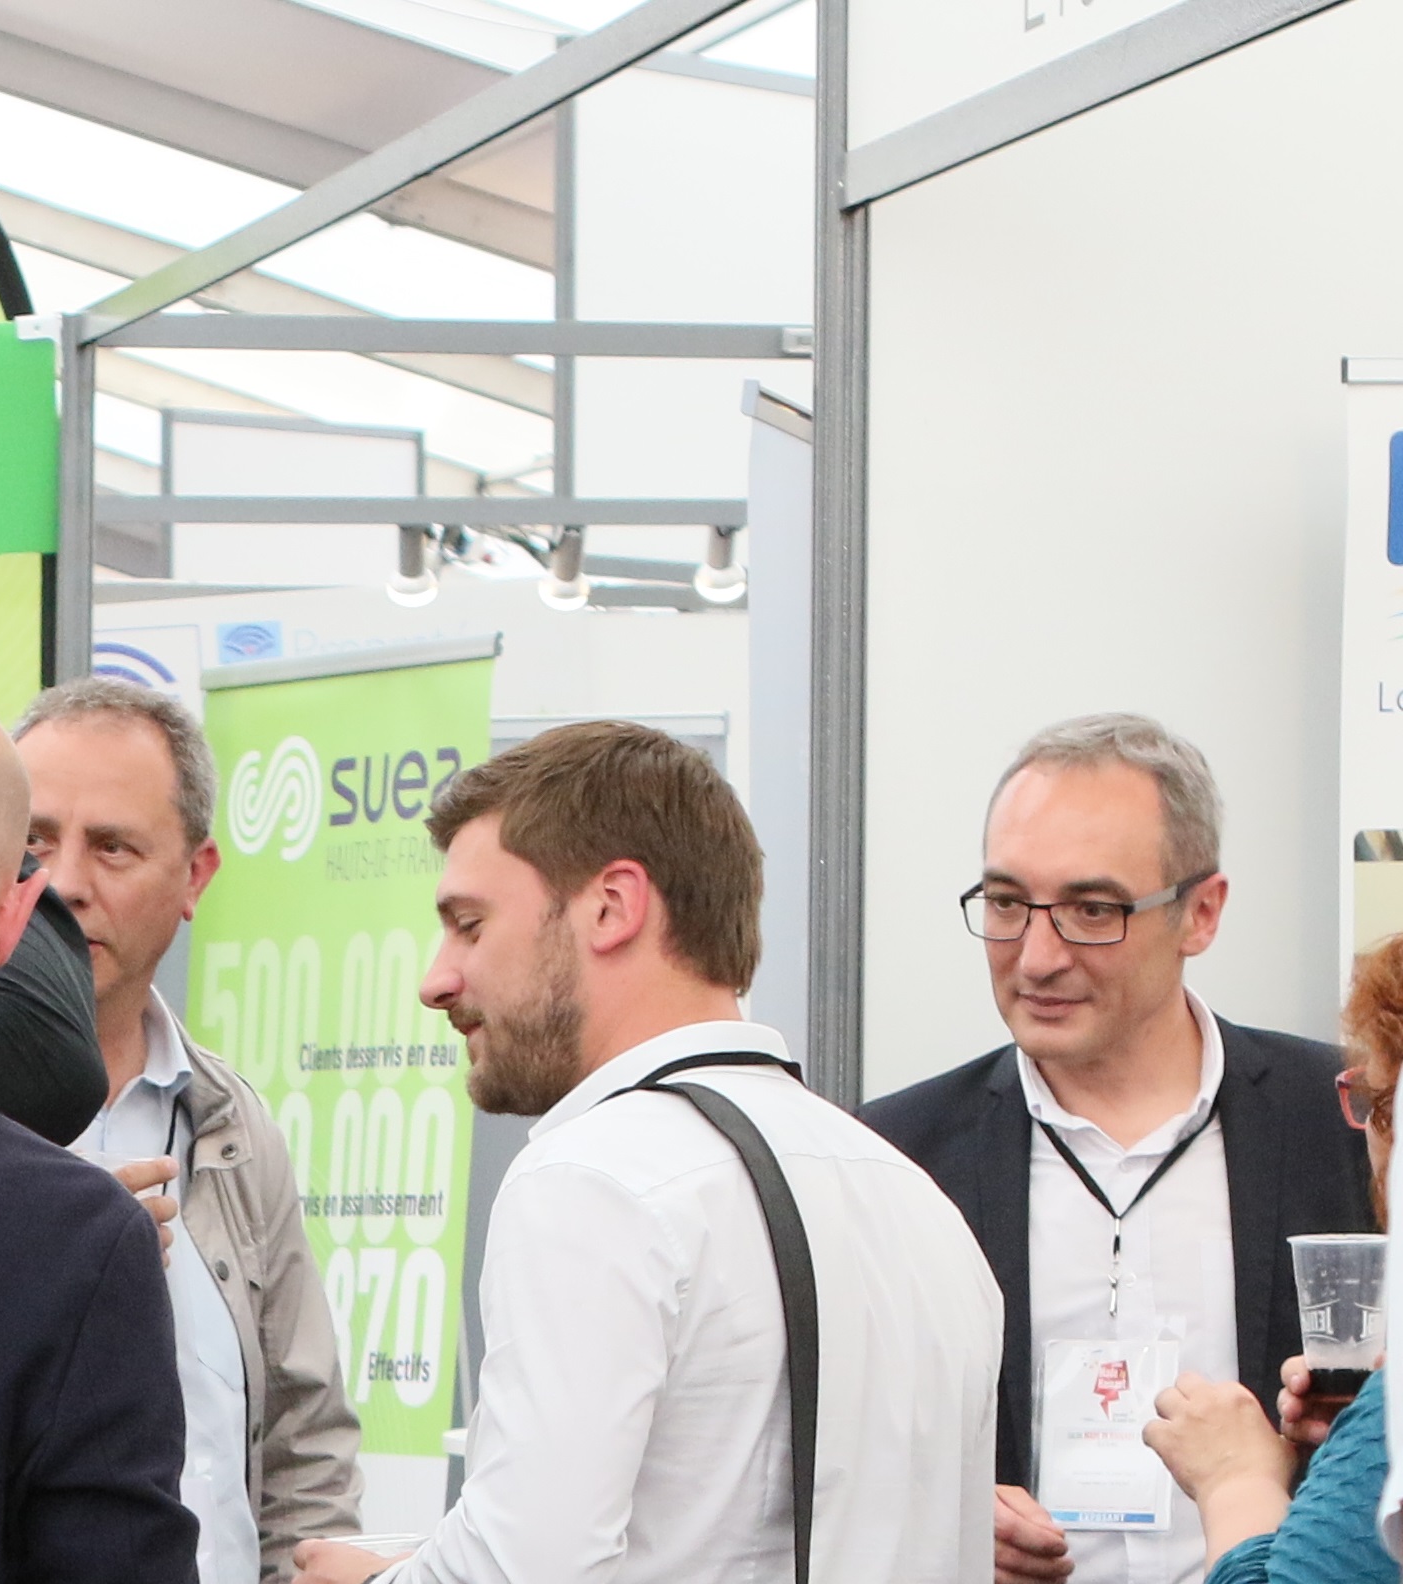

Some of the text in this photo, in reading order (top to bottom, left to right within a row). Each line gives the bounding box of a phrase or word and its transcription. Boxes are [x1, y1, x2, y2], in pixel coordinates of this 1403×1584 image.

[201, 935, 321, 1092] 500
[407, 1045, 426, 1067] en
[431, 1044, 459, 1067] eau
[329, 1086, 455, 1246] 000
[367, 1351, 430, 1383] Effectifs
